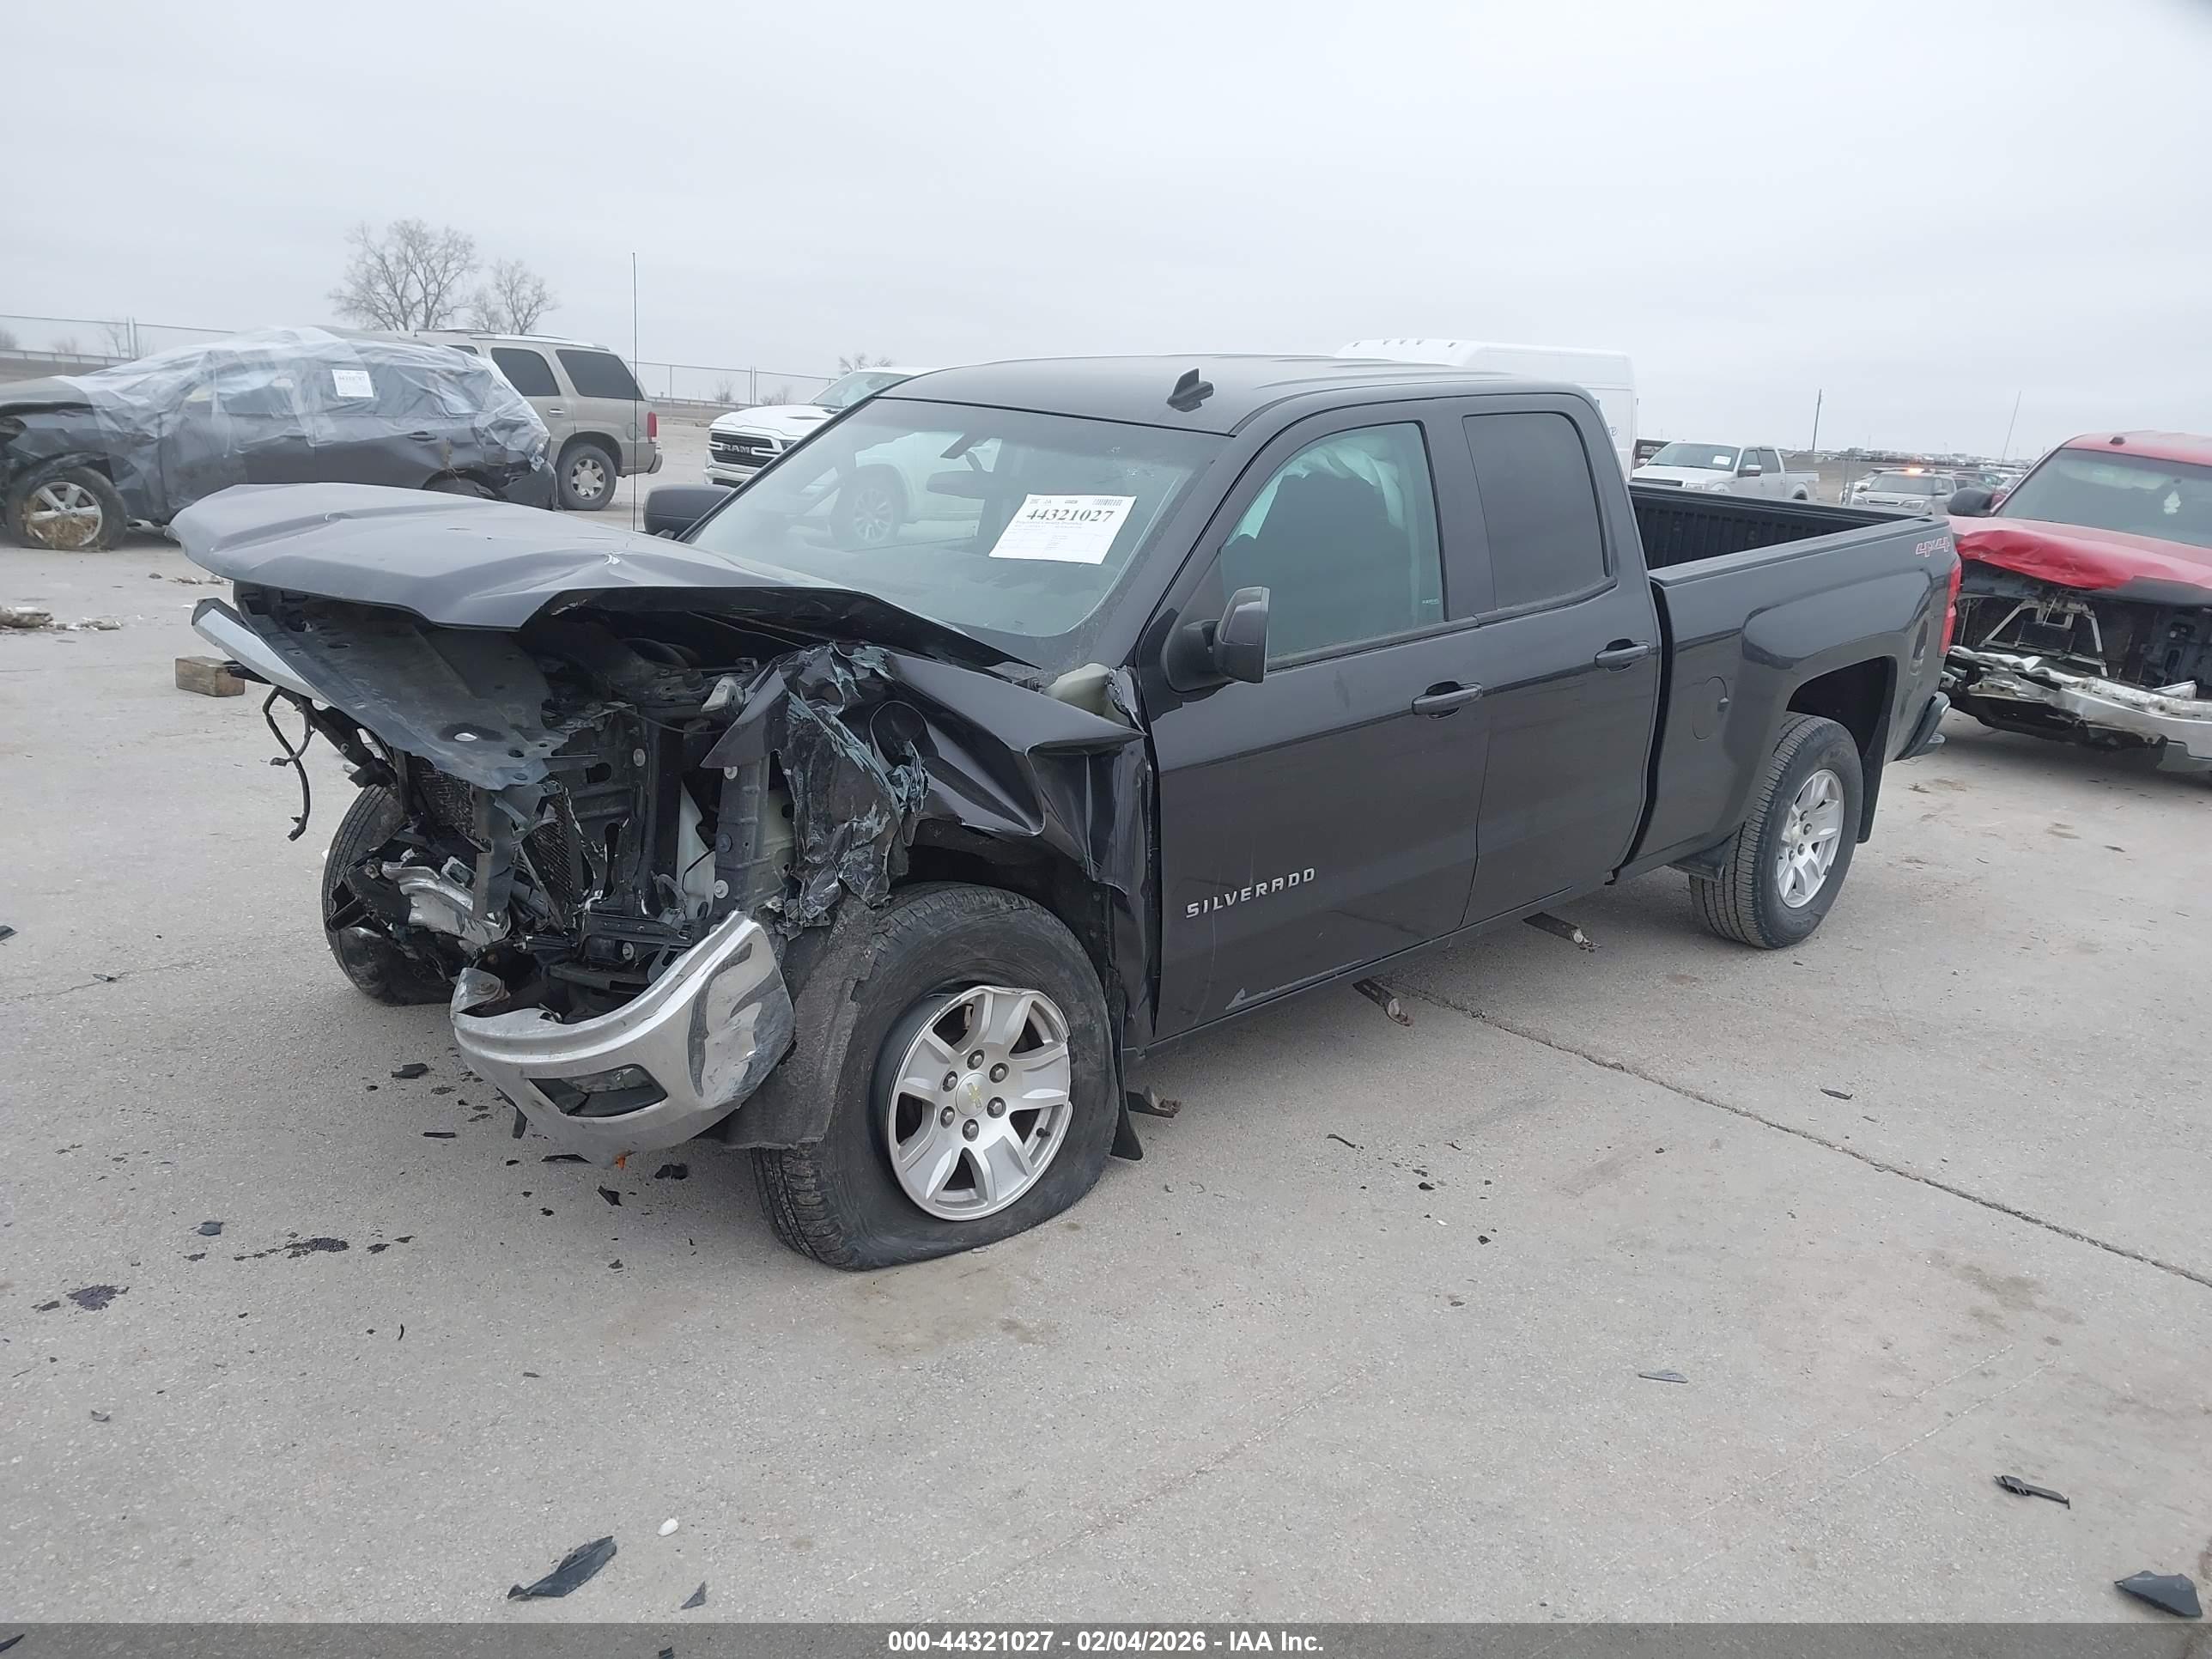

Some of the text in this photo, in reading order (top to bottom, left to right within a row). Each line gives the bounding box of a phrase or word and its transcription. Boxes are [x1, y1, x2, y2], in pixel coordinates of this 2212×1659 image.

[722, 444, 750, 453] RAM
[1026, 508, 1115, 522] 44321027
[1186, 868, 1316, 919] SILVERADO
